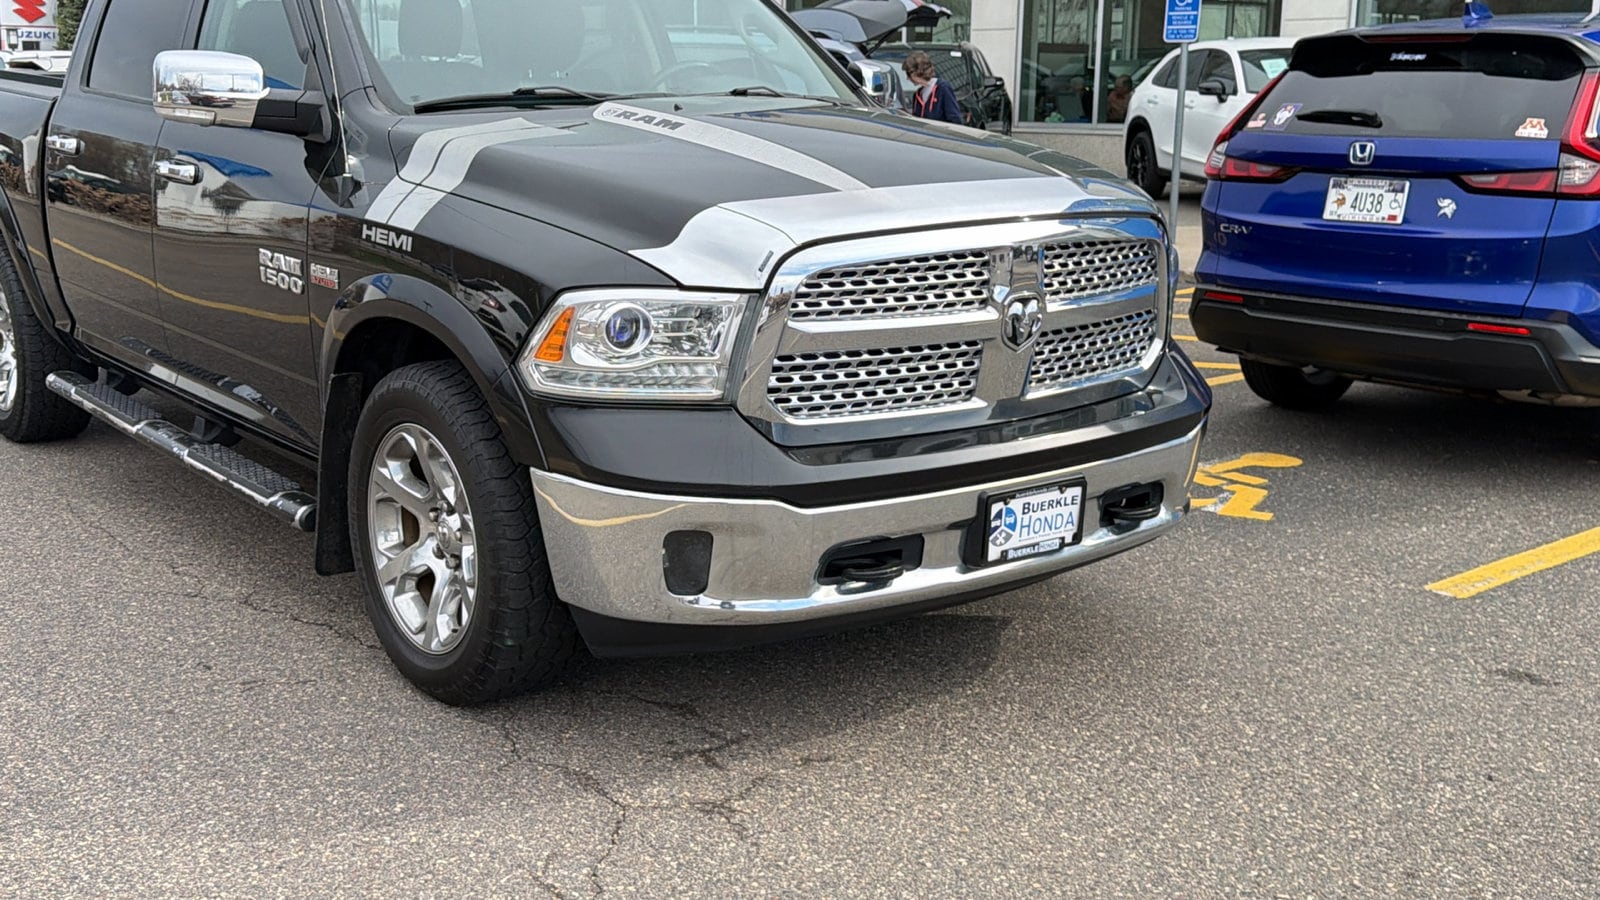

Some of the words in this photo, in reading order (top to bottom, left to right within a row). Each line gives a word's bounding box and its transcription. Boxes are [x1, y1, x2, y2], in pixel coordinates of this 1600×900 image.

[17, 31, 56, 39] UZUKI
[614, 110, 685, 130] RAM
[1350, 191, 1385, 214] 4U38
[362, 224, 413, 252] HEMI
[1220, 223, 1253, 235] CR-V
[259, 248, 302, 276] RAM
[260, 266, 304, 294] 1500
[1022, 495, 1078, 515] BUERKLE
[1019, 512, 1075, 538] HONDA
[1008, 546, 1039, 559] BUERKLE
